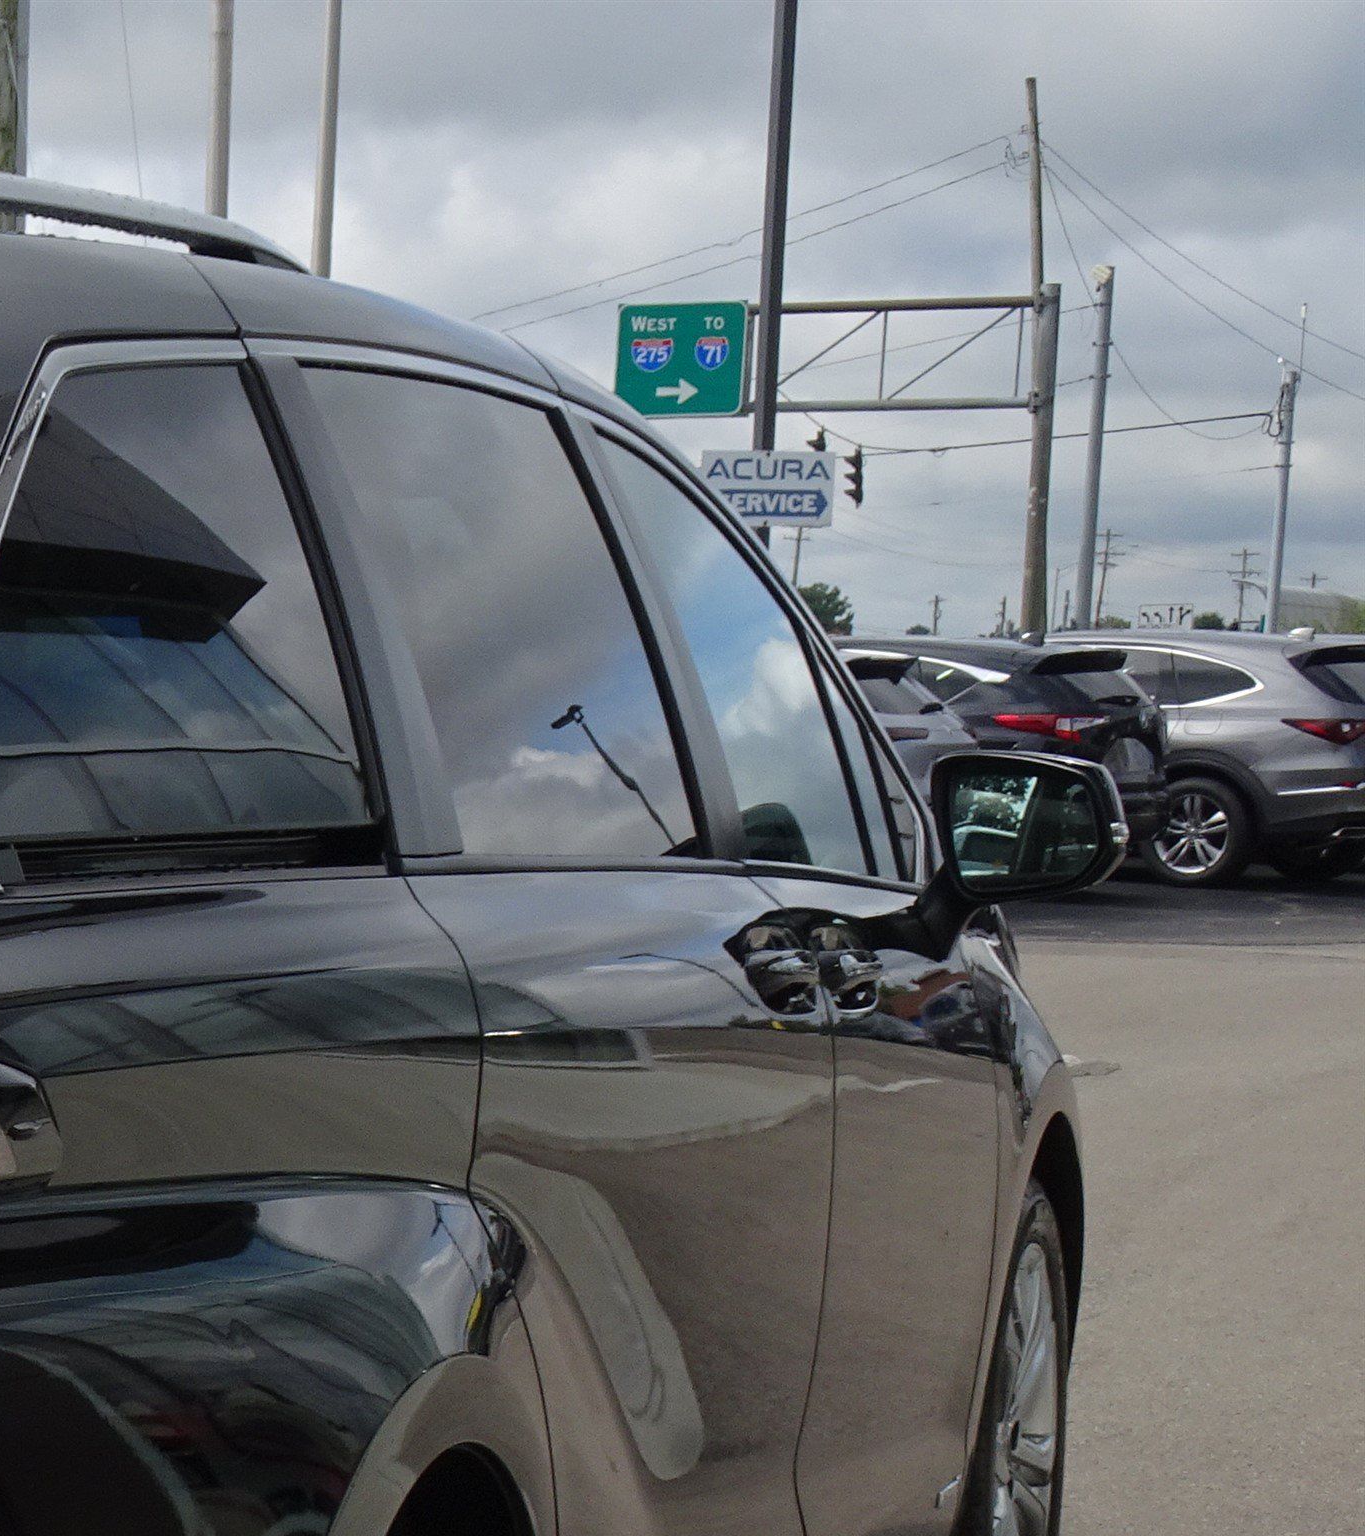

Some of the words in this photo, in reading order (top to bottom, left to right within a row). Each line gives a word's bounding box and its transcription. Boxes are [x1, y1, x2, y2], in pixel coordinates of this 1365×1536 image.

[631, 316, 677, 332] WEST
[704, 316, 725, 330] TO
[636, 347, 669, 363] 275
[703, 345, 722, 364] 71
[707, 458, 831, 480] ACURA
